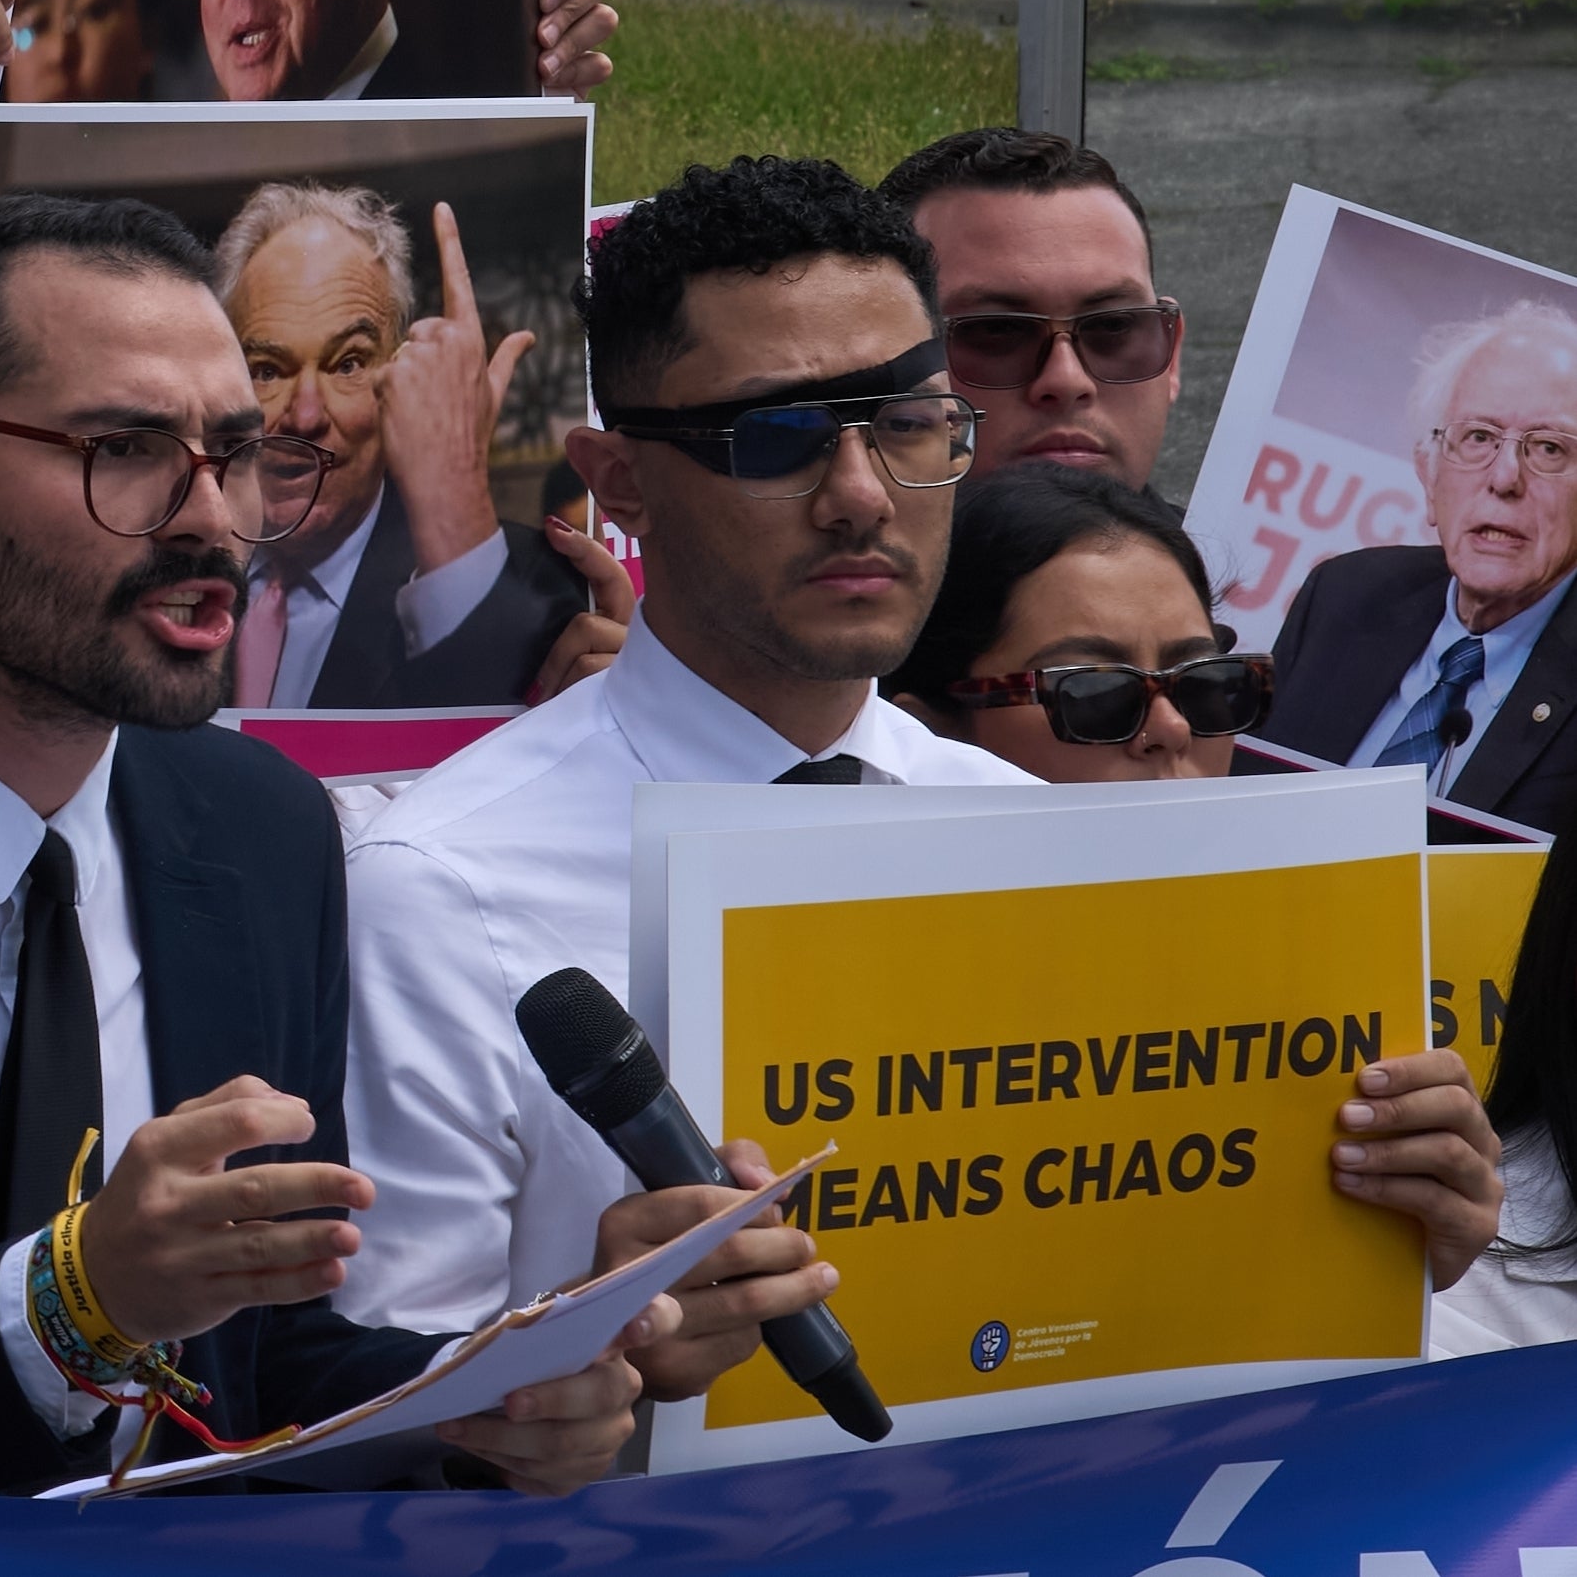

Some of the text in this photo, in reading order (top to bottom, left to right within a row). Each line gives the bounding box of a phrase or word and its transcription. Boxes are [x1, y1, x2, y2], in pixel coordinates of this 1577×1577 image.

[1243, 443, 1436, 547] RUG
[764, 1059, 854, 1125] US
[876, 1012, 1382, 1117] INTERVENTION
[1024, 1128, 1258, 1209] CHAOS
[61, 1249, 92, 1315] Justicia
[1016, 1325, 1047, 1338] Centro
